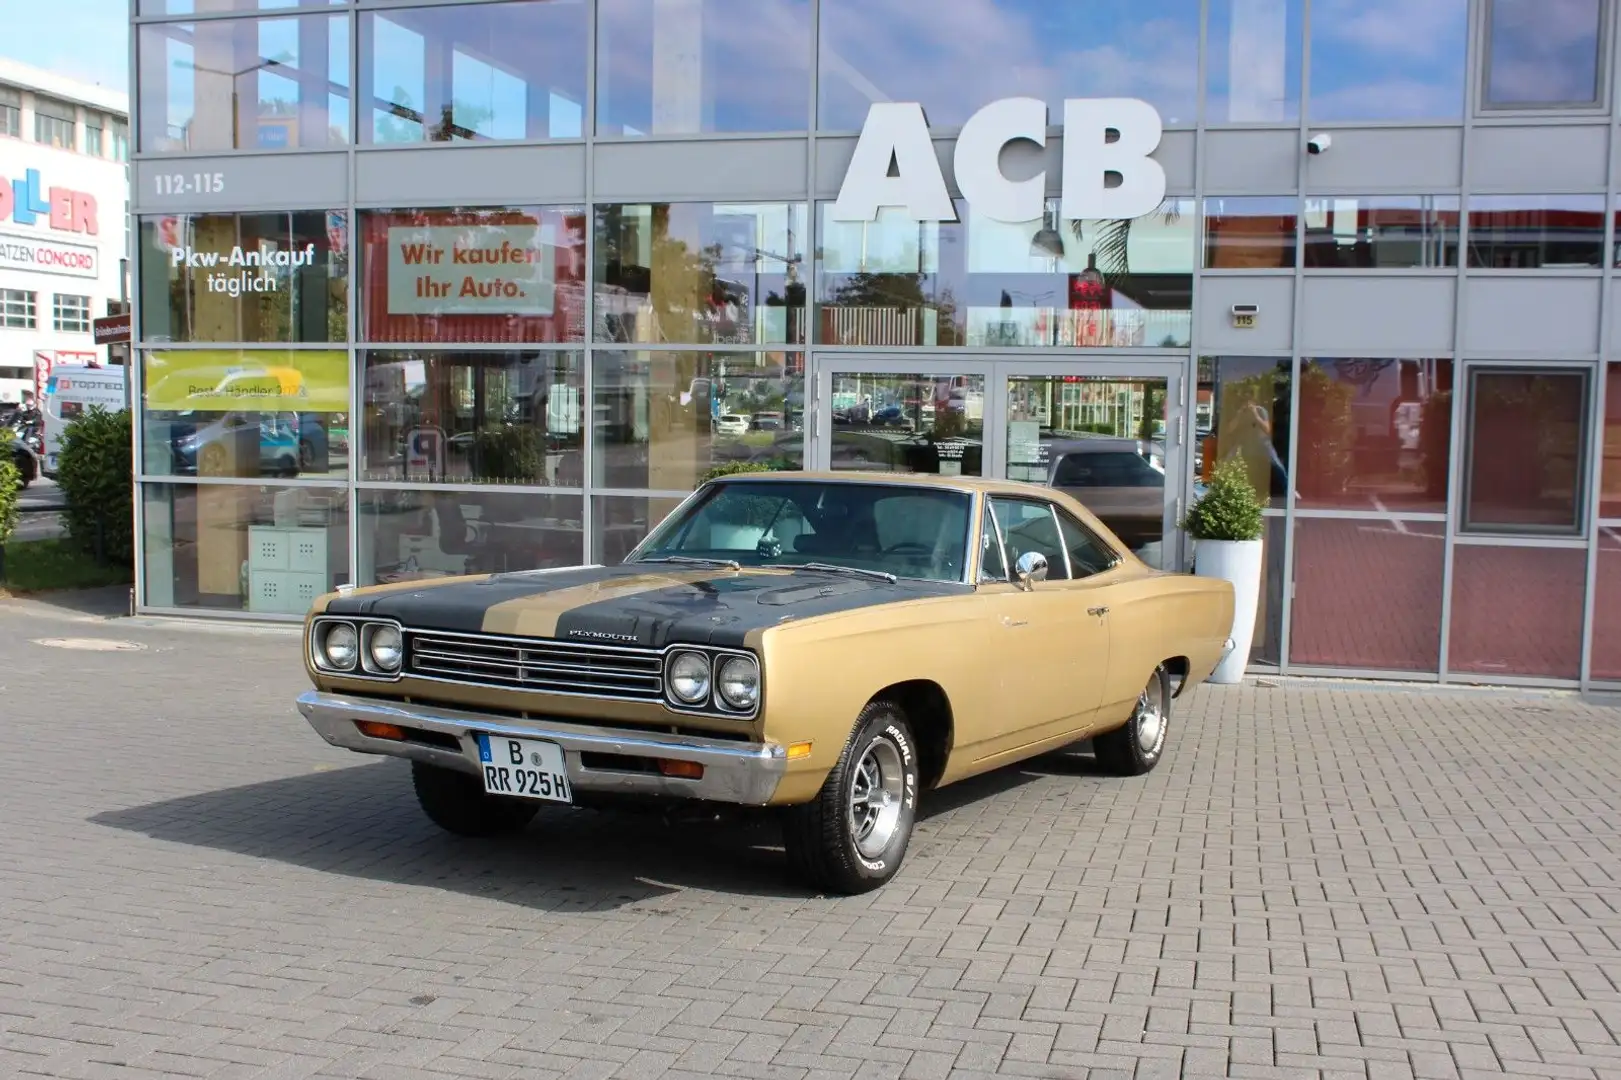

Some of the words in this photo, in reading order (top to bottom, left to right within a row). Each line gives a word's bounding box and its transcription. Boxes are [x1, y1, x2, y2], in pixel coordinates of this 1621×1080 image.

[832, 96, 1167, 224] ACB
[155, 173, 224, 195] 112-115
[37, 248, 93, 270] CONCORD
[171, 243, 315, 268] Pkw-Ankauf
[400, 243, 444, 265] Wir
[452, 241, 541, 265] kaufen
[207, 271, 277, 297] täglich
[416, 275, 452, 298] Ihr
[458, 275, 527, 298] Auto.
[1236, 315, 1253, 325] 115
[569, 629, 639, 641] PLYMOUTH
[508, 740, 524, 765] B
[886, 725, 912, 766] RADIAL
[485, 765, 511, 792] RR
